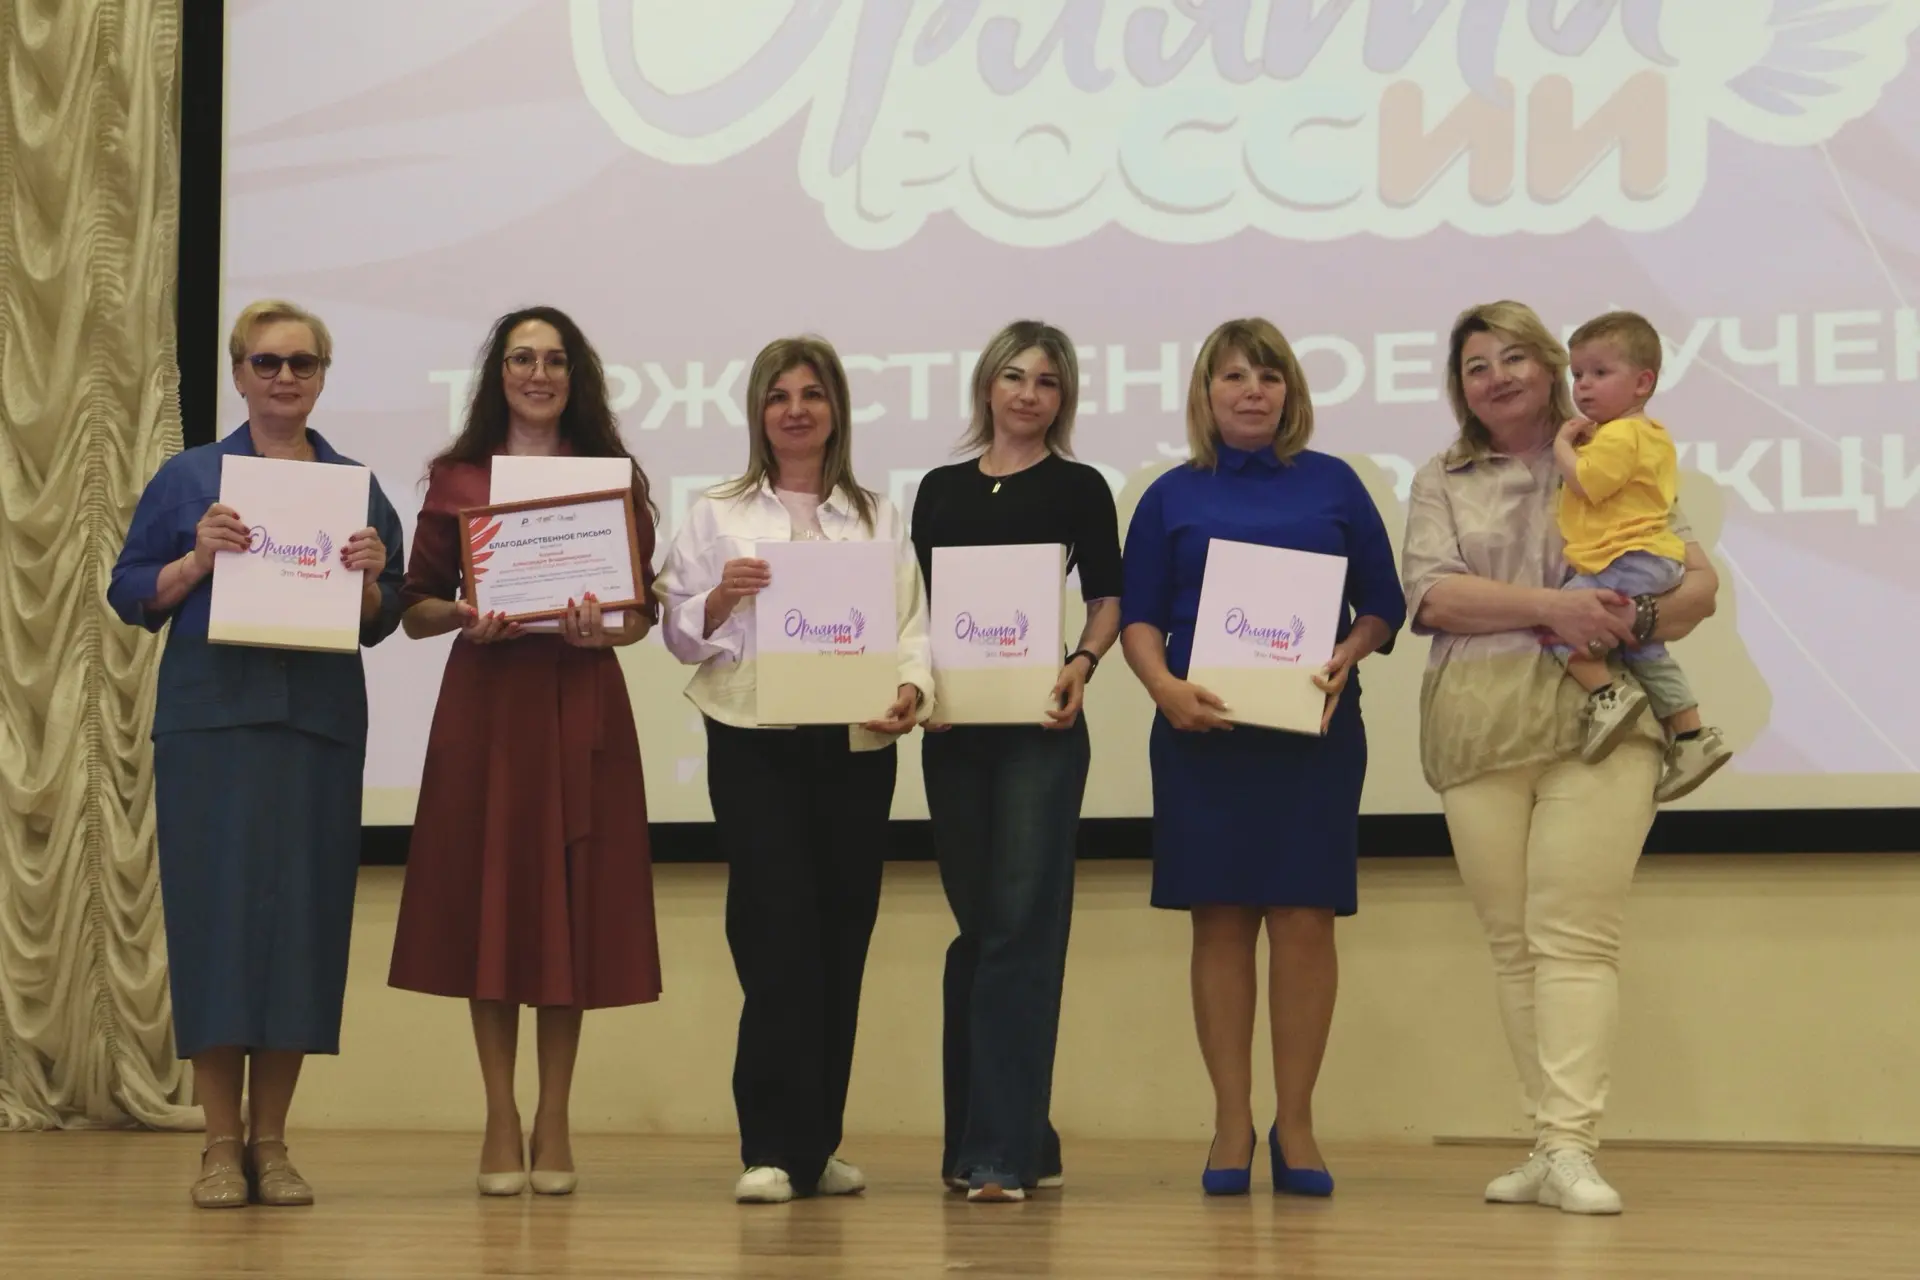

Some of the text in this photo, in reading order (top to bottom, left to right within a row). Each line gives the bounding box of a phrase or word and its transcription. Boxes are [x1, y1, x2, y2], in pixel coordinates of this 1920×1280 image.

[247, 525, 318, 558] Орлята
[489, 528, 612, 550] БЛАГОДАРСТВЕННОЕ ПИСЬМО
[784, 608, 852, 640] Орлята
[955, 611, 1016, 642] Орлята
[1225, 607, 1291, 641] Орлята
